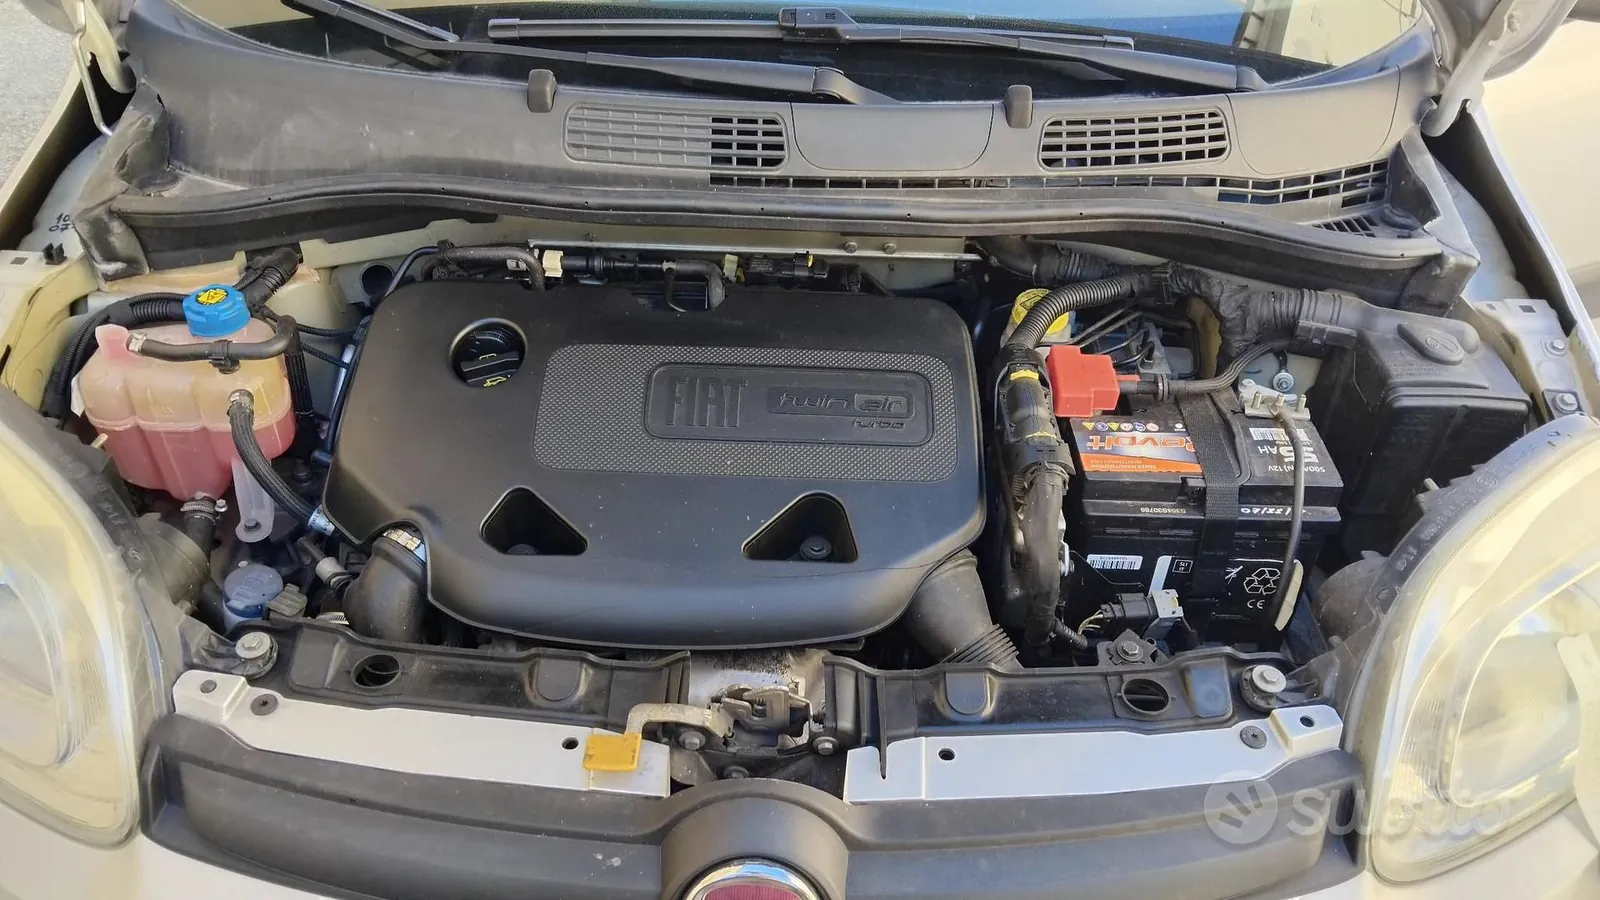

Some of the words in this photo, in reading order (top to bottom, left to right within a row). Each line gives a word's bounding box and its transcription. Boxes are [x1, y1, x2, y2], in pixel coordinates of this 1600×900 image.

[665, 375, 748, 428] FIAT
[778, 392, 850, 410] twin
[859, 395, 903, 413] air
